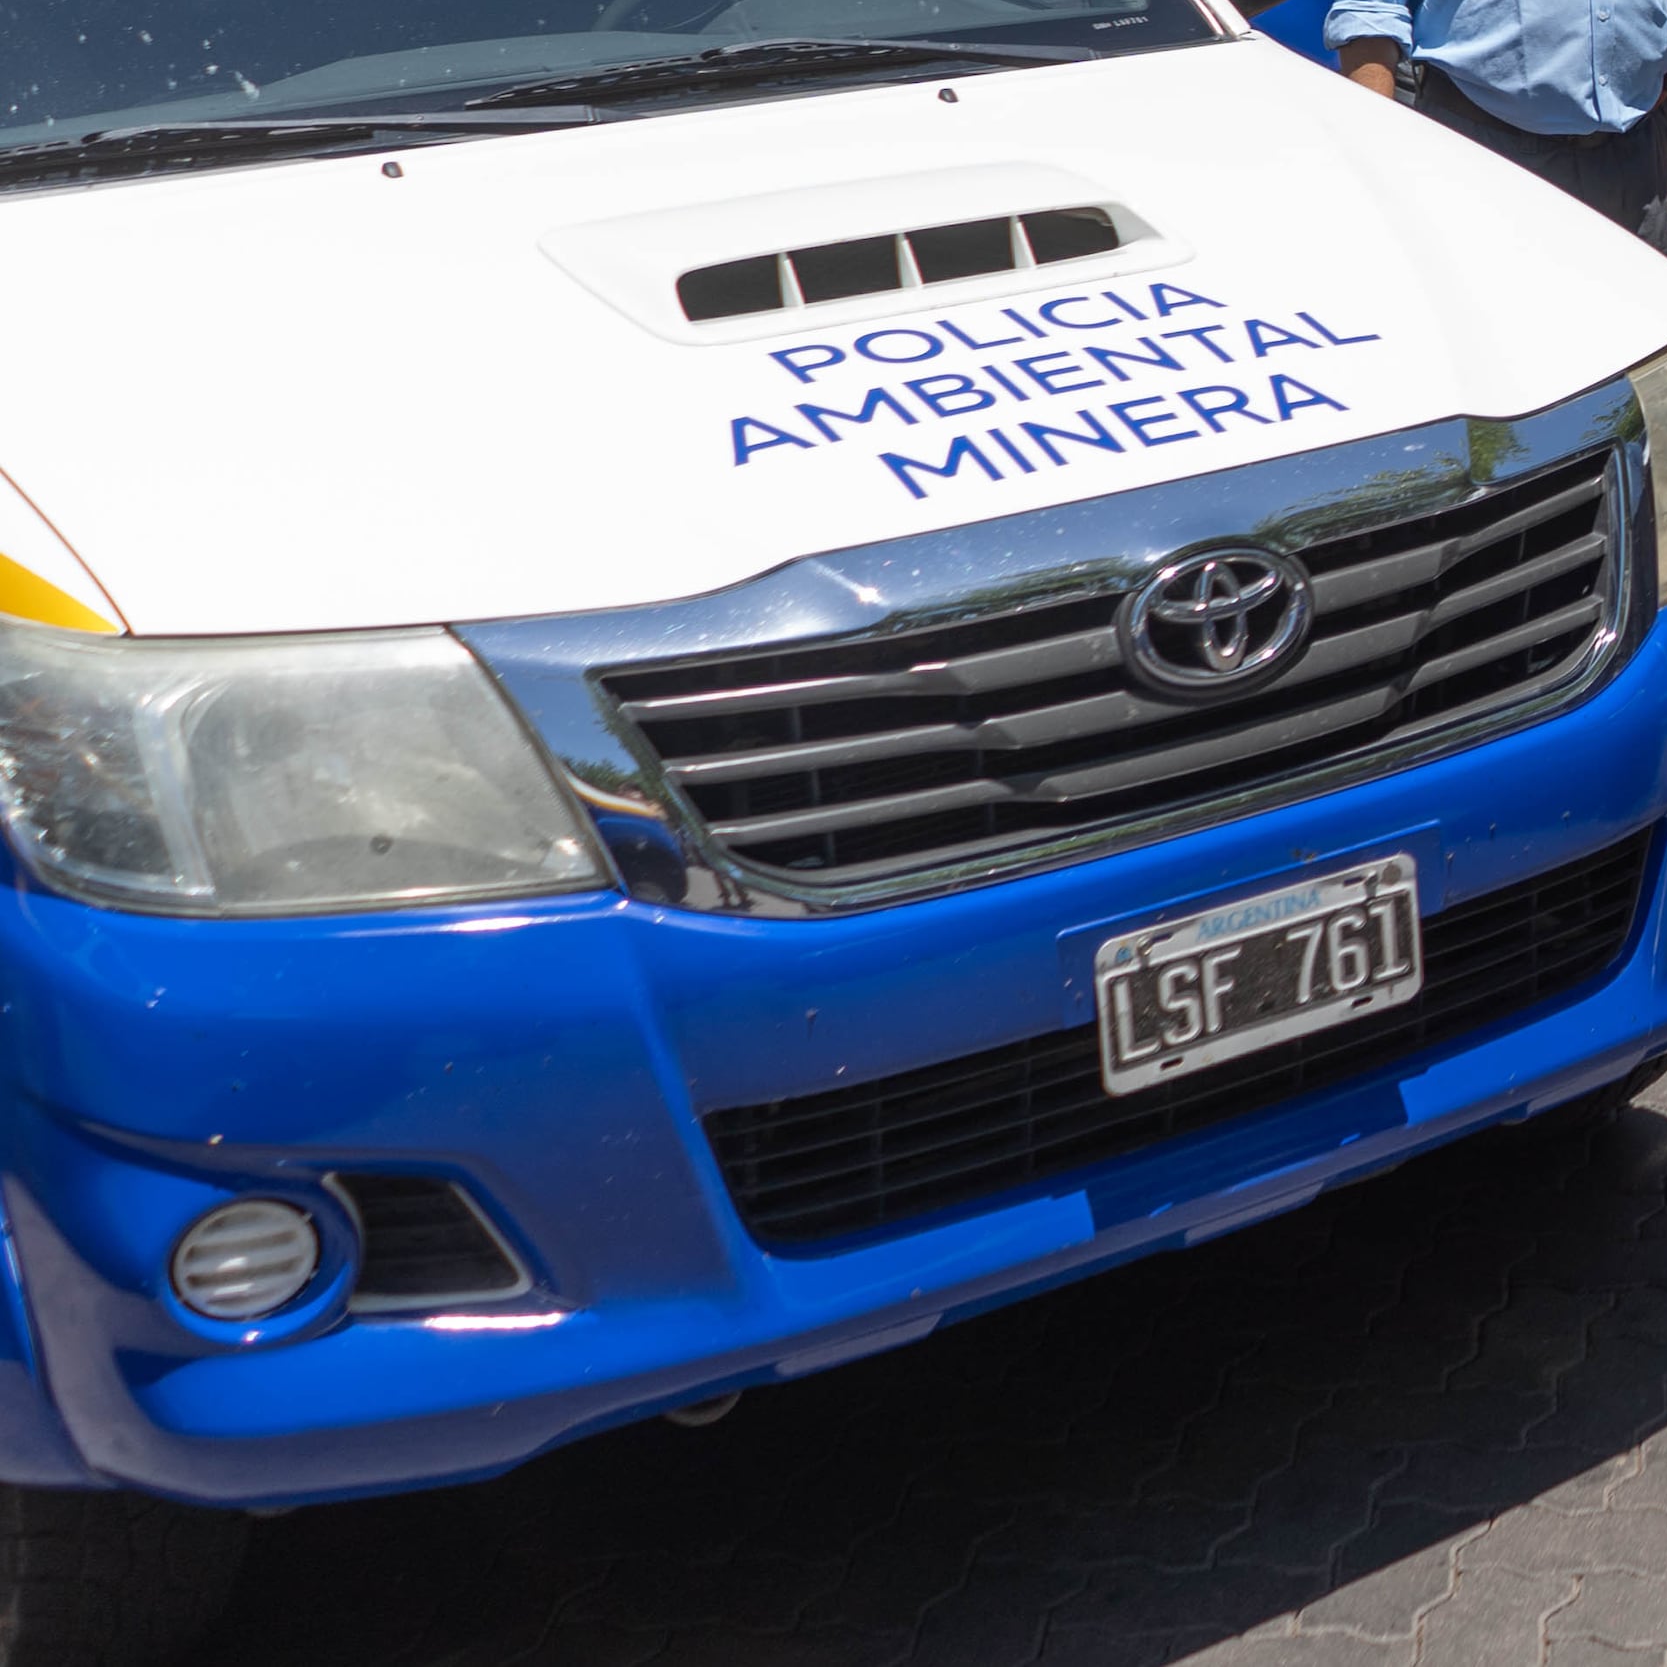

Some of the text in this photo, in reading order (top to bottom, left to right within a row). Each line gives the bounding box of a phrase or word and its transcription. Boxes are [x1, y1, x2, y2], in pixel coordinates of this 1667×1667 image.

[731, 312, 1383, 468] AMBIENTAL
[877, 374, 1351, 500] MINERA
[1113, 897, 1410, 1062] LSF 761
[1198, 889, 1321, 937] ARGENTINA
